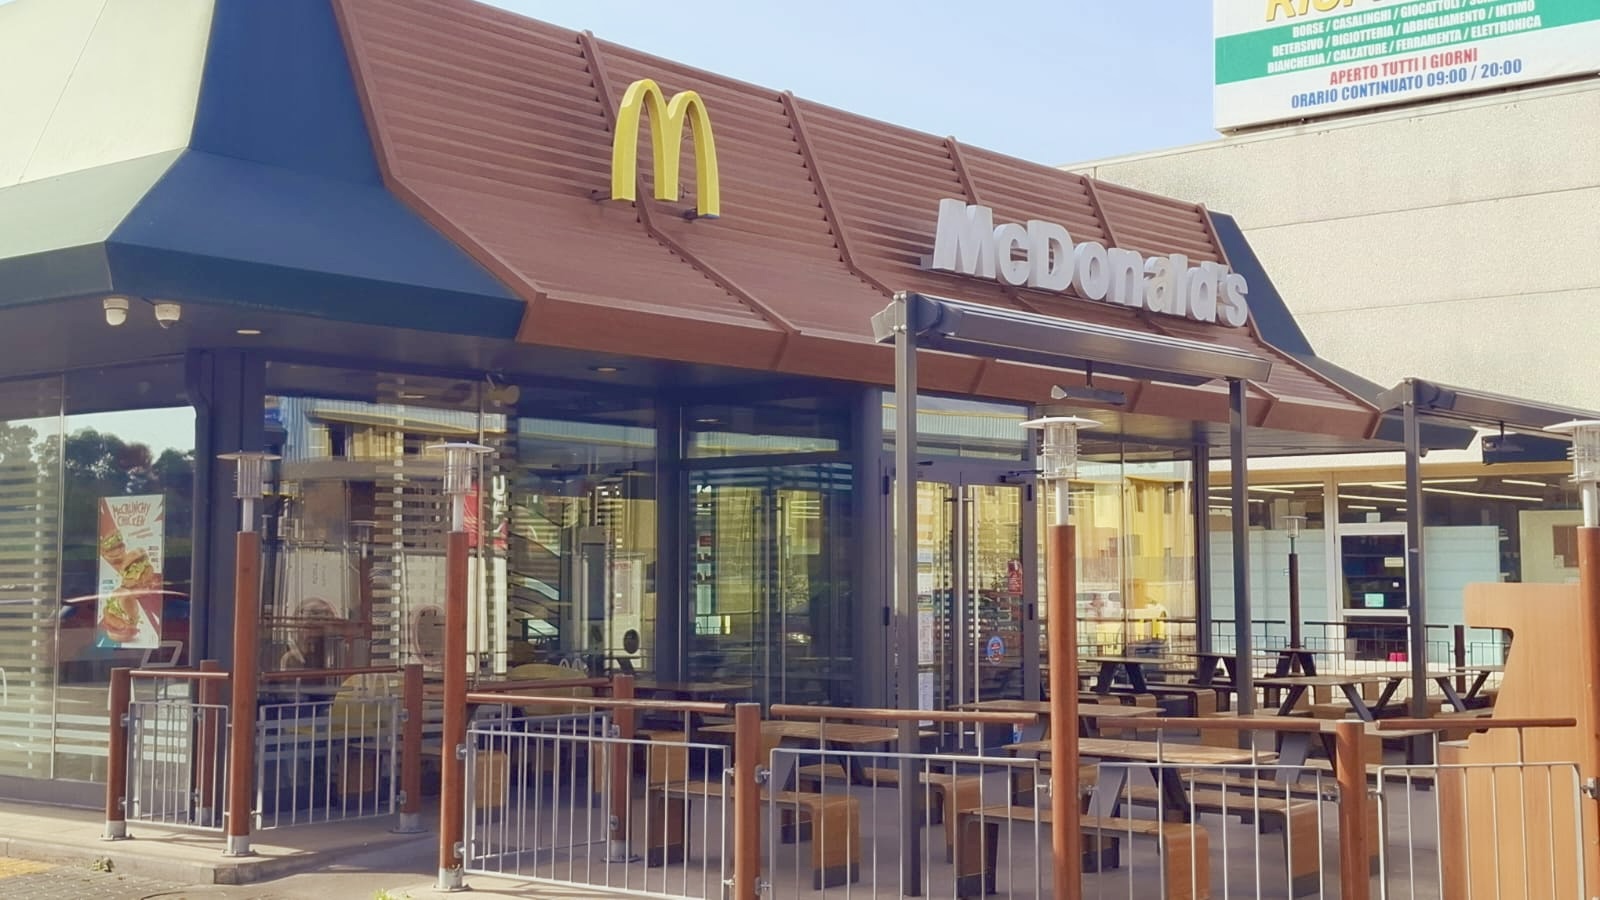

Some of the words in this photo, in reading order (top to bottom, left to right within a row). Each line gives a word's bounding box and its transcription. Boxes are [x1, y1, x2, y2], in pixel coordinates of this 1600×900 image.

[1267, 53, 1325, 74] BIANCHERIA
[1333, 42, 1388, 62] CALZATURE
[1396, 29, 1462, 52] FERRAMENTA
[1471, 15, 1542, 38] ELETTRONICA
[1272, 37, 1323, 57] DETERSIVO
[1332, 25, 1394, 47] BIGIOTTERIA
[1402, 9, 1486, 34] ABBIGLIAMENTO
[1495, 0, 1535, 17] INTIMO
[1293, 23, 1324, 38] BORSE
[1333, 10, 1392, 30] CASALINGHI
[1292, 88, 1338, 109] ORARIO
[1342, 75, 1423, 101] CONTINUATO
[1427, 66, 1467, 87] 09:00
[1481, 59, 1522, 79] 20:00
[1329, 65, 1378, 85] APERTO
[1382, 57, 1418, 77] TUTTI
[1422, 56, 1427, 70] I
[1430, 48, 1478, 68] GIORNI
[932, 198, 1248, 328] McDonald's
